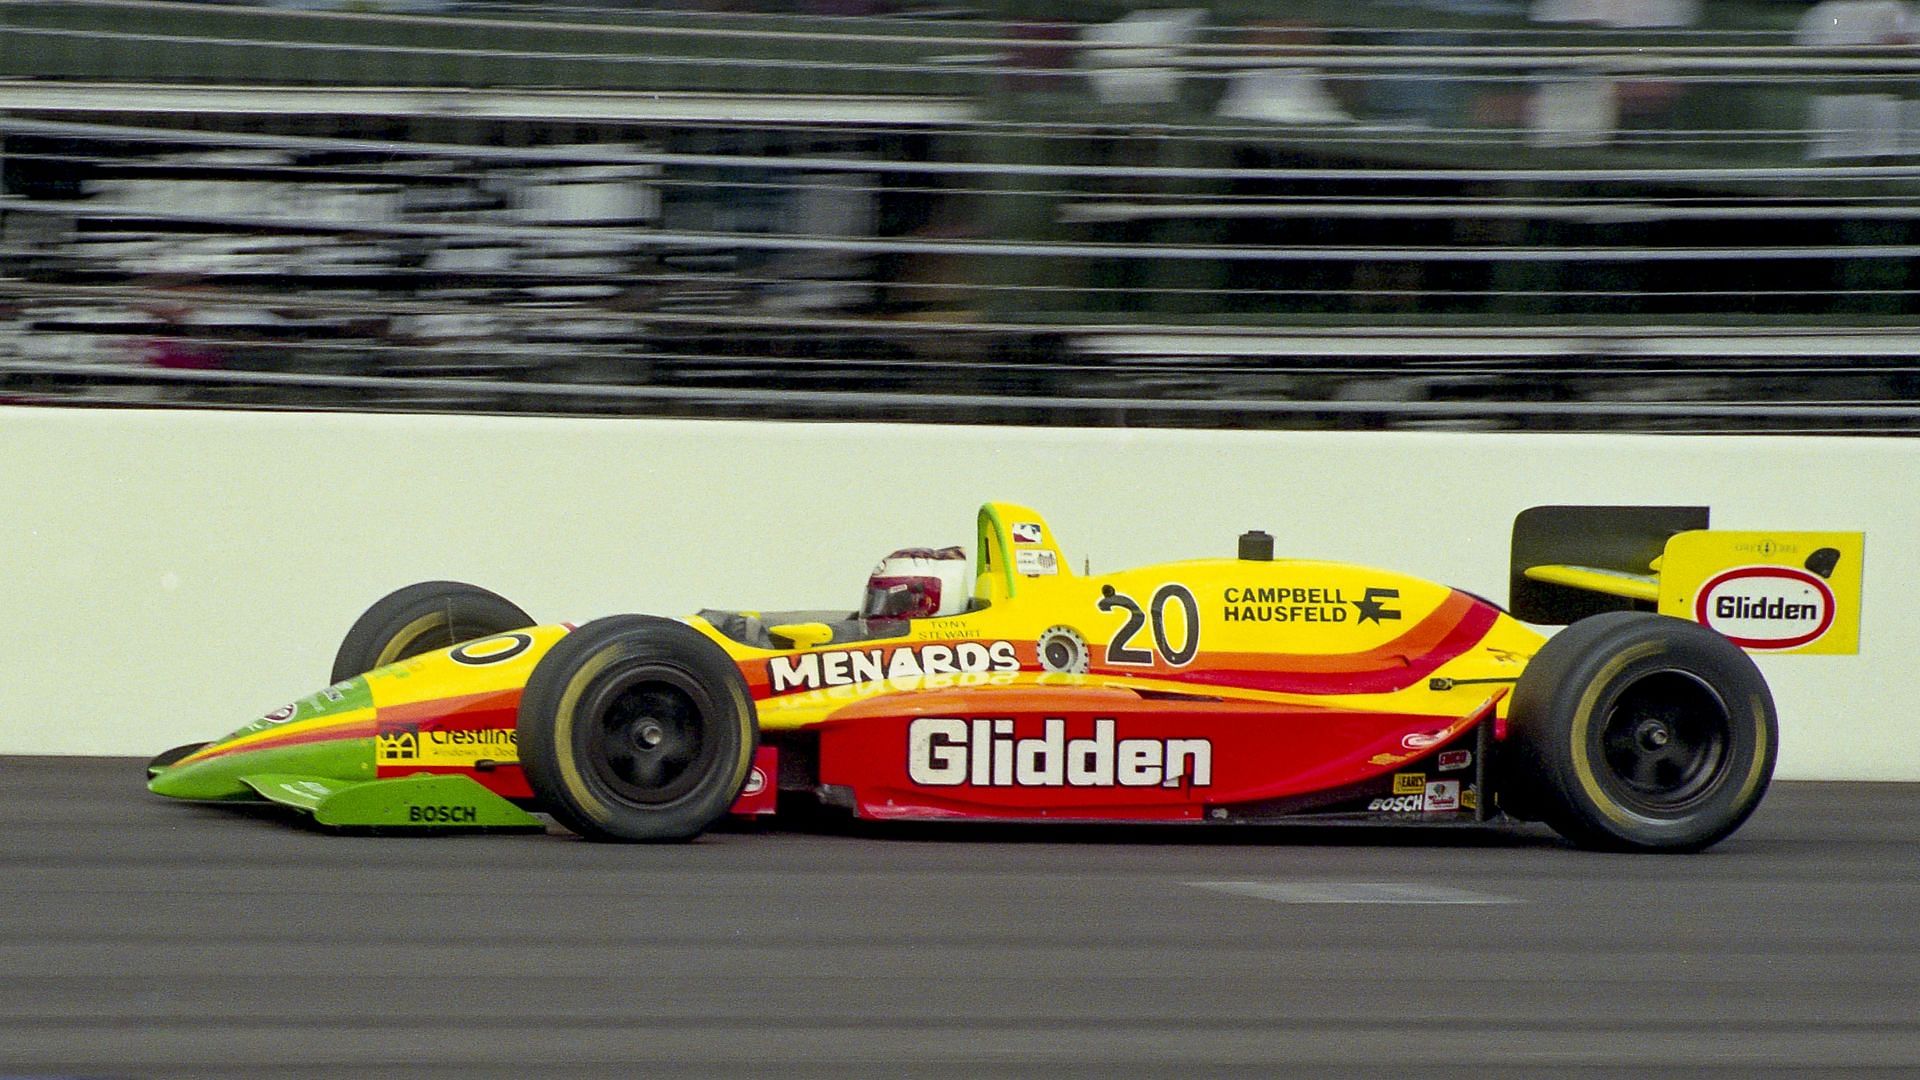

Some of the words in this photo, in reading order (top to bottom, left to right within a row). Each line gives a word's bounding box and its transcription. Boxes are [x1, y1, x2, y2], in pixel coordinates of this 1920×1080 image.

[1224, 587, 1347, 605] CAMPBELL
[1224, 606, 1347, 623] HAUSFELD
[1716, 596, 1817, 620] Glidden
[931, 620, 967, 629] TONY
[1098, 583, 1200, 667] 20
[918, 630, 981, 640] STEWART
[769, 641, 1020, 692] MENARDS
[430, 724, 518, 745] Crestline
[907, 717, 1213, 788] Glidden
[1368, 794, 1423, 812] BOSCH
[409, 805, 477, 822] BOSCH
